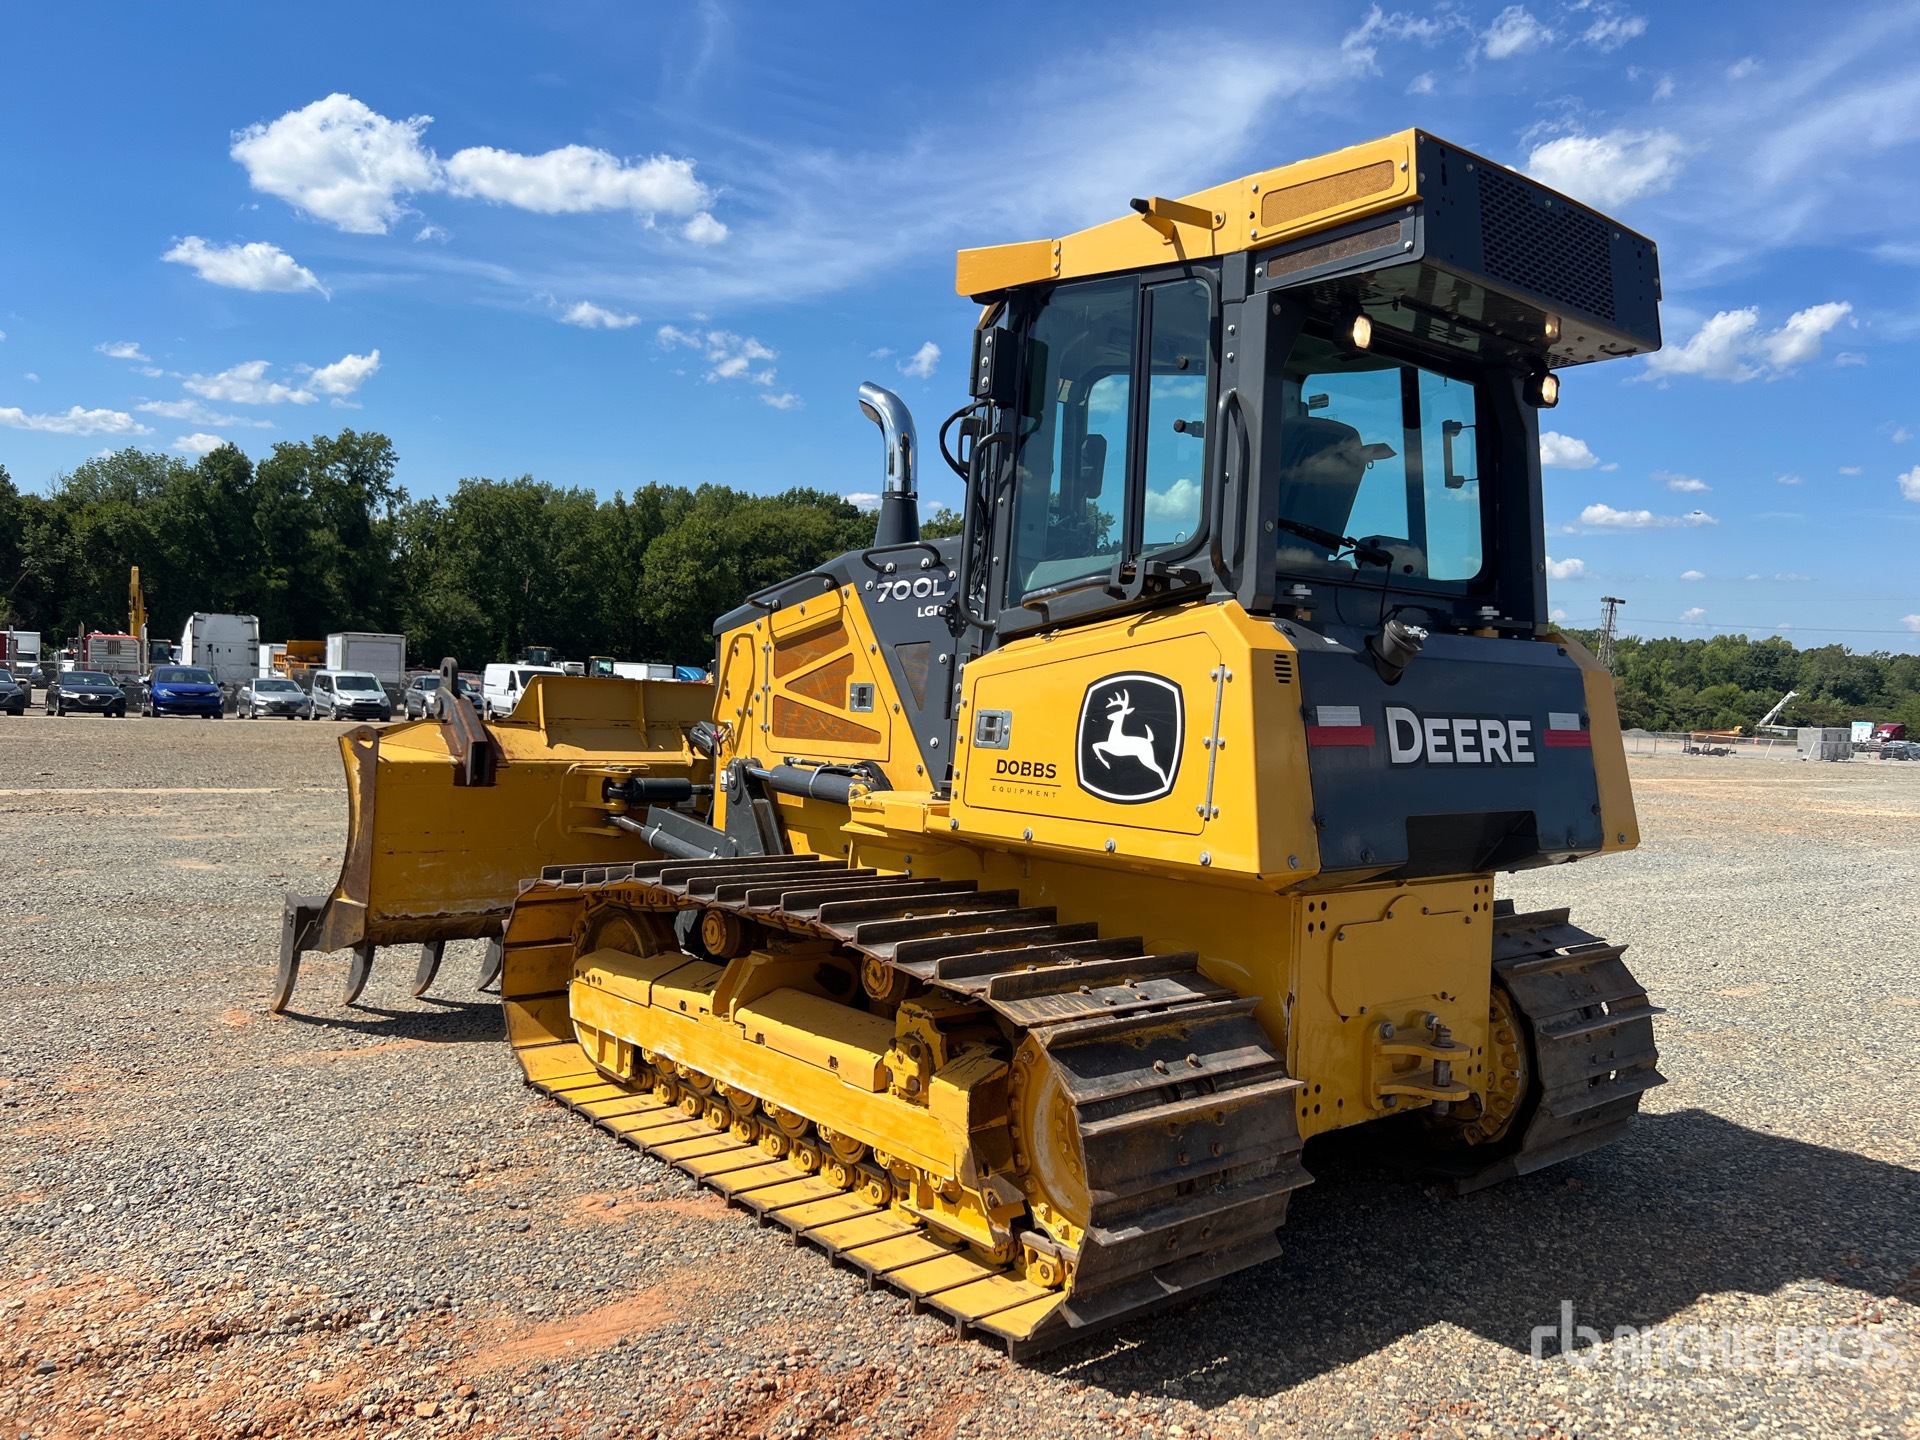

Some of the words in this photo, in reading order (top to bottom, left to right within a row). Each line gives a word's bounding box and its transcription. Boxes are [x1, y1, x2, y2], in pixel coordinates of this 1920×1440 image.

[877, 577, 945, 603] 700L
[1385, 706, 1535, 764] DEERE
[996, 759, 1057, 779] DOBBS
[992, 785, 1056, 798] EQUIPMENT
